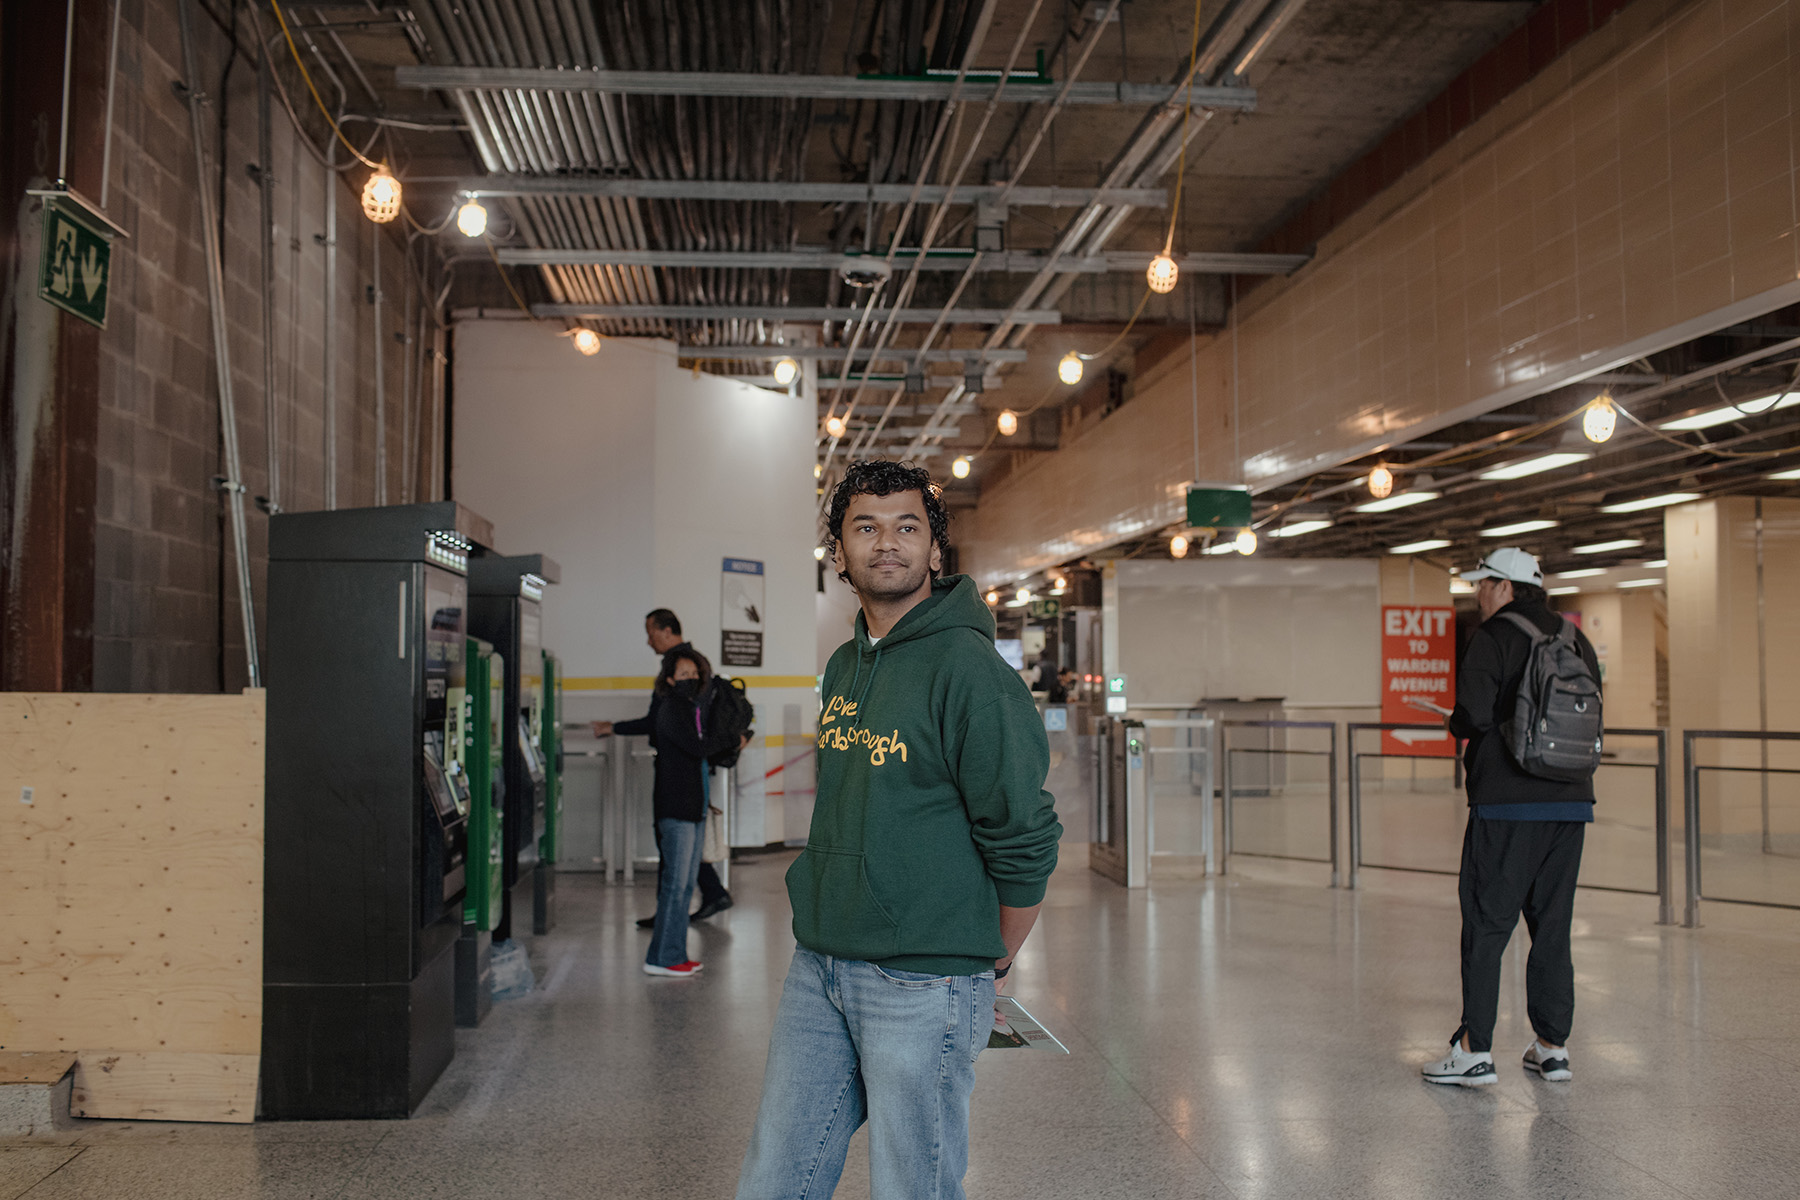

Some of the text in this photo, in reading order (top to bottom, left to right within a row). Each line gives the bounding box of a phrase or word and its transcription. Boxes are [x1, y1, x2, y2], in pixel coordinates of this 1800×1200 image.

[1385, 609, 1452, 637] EXIT
[1408, 640, 1429, 655] TO
[1387, 658, 1450, 674] WARDEN
[1389, 677, 1448, 692] AVENUE
[822, 695, 858, 725] Love
